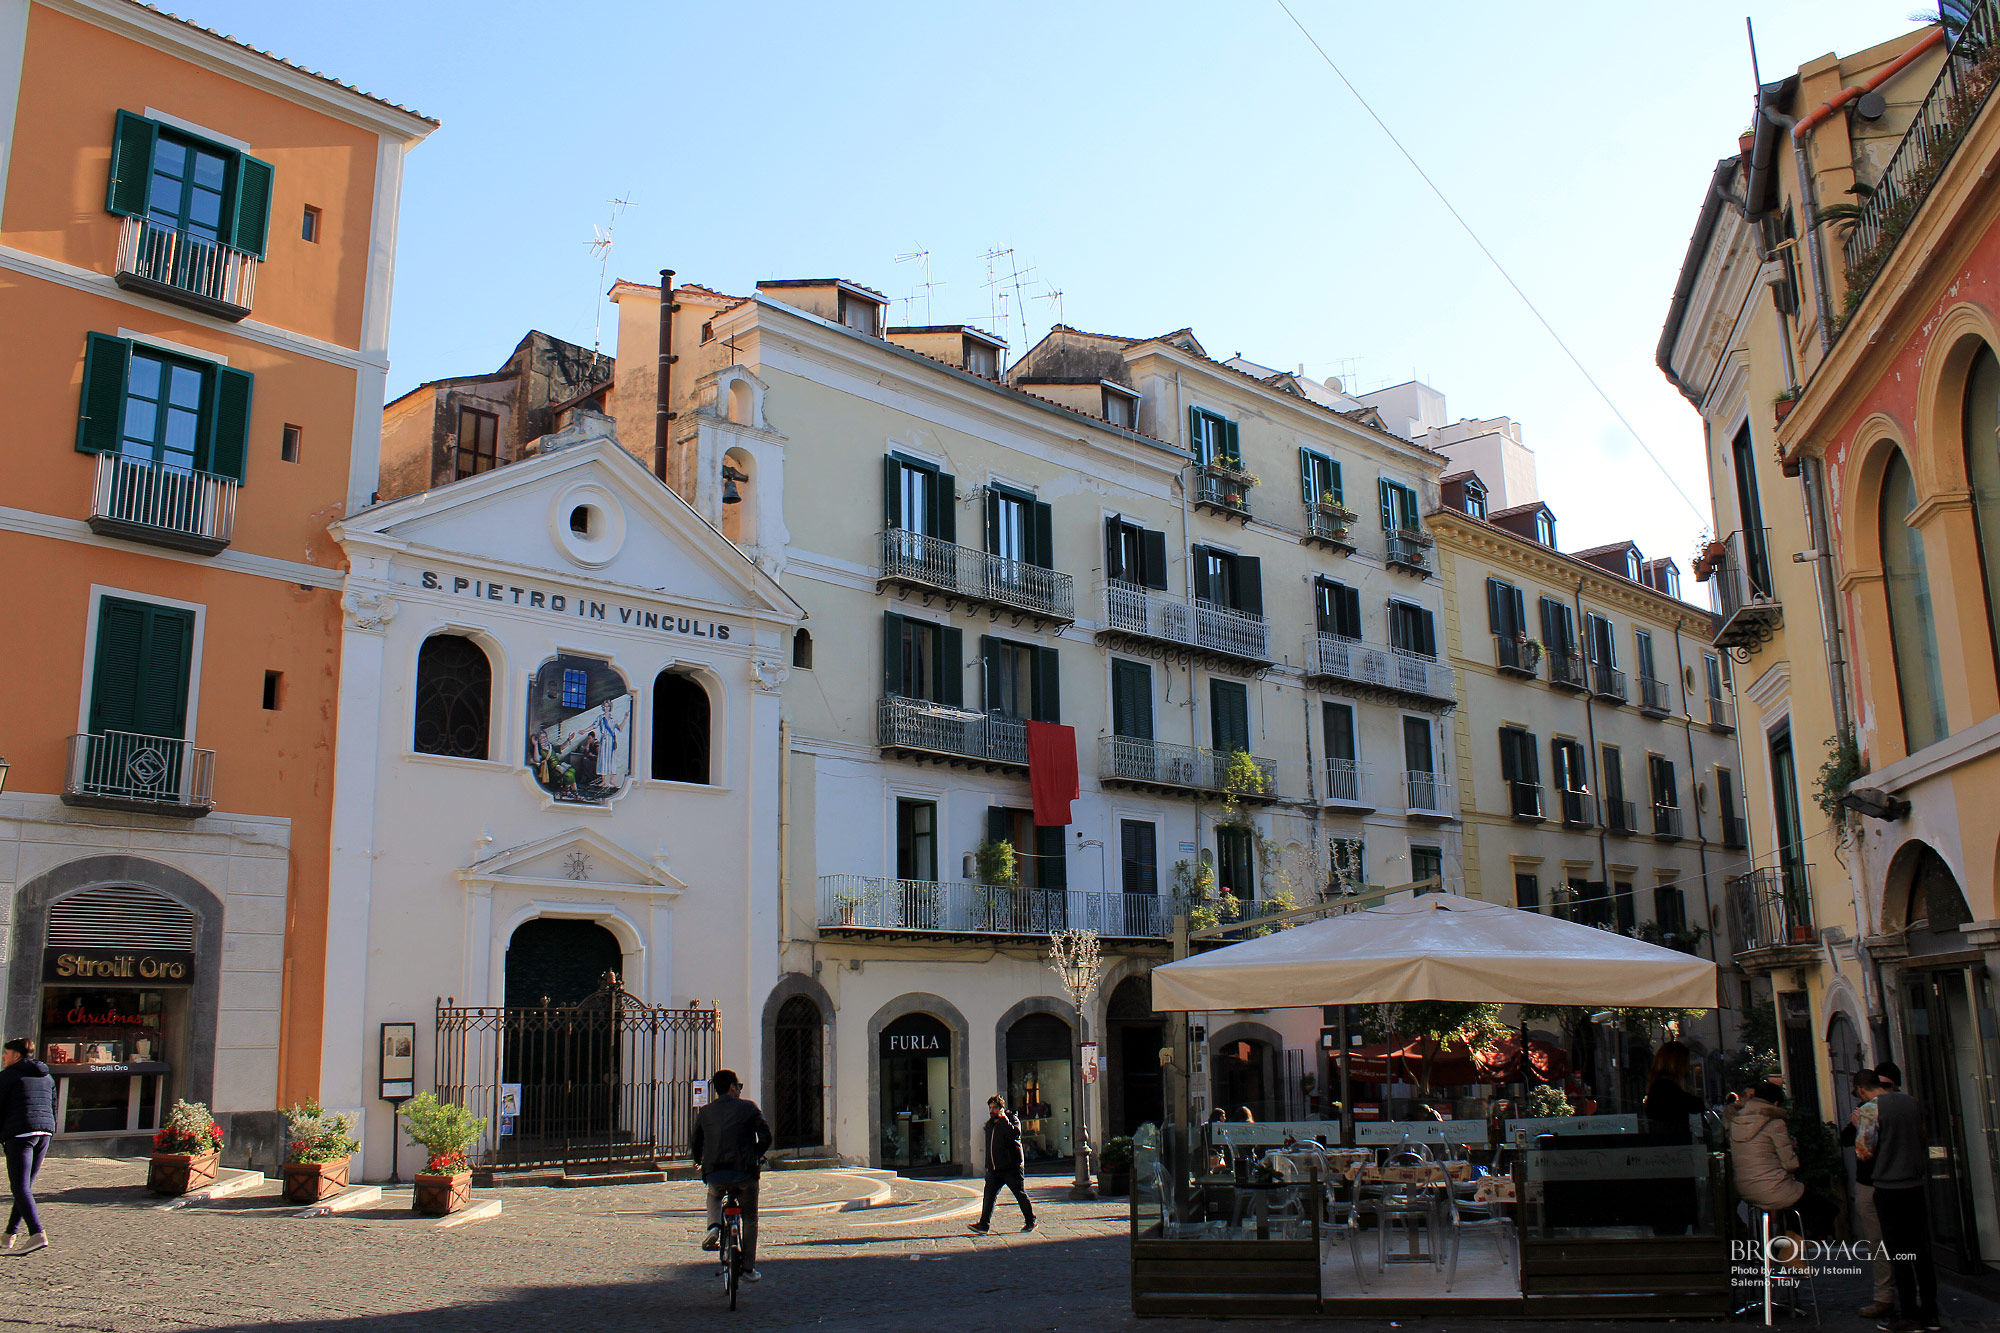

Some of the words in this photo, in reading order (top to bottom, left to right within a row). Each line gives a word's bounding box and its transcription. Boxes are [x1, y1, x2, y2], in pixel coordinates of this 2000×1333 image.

[422, 571, 443, 590] S.
[454, 576, 567, 612] PIETRO
[579, 600, 606, 620] IN
[619, 607, 731, 640] VINCULIS
[56, 953, 136, 978] Stroili
[139, 956, 187, 979] Oro
[67, 1007, 144, 1024] Christmas
[890, 1034, 940, 1050] FURLA
